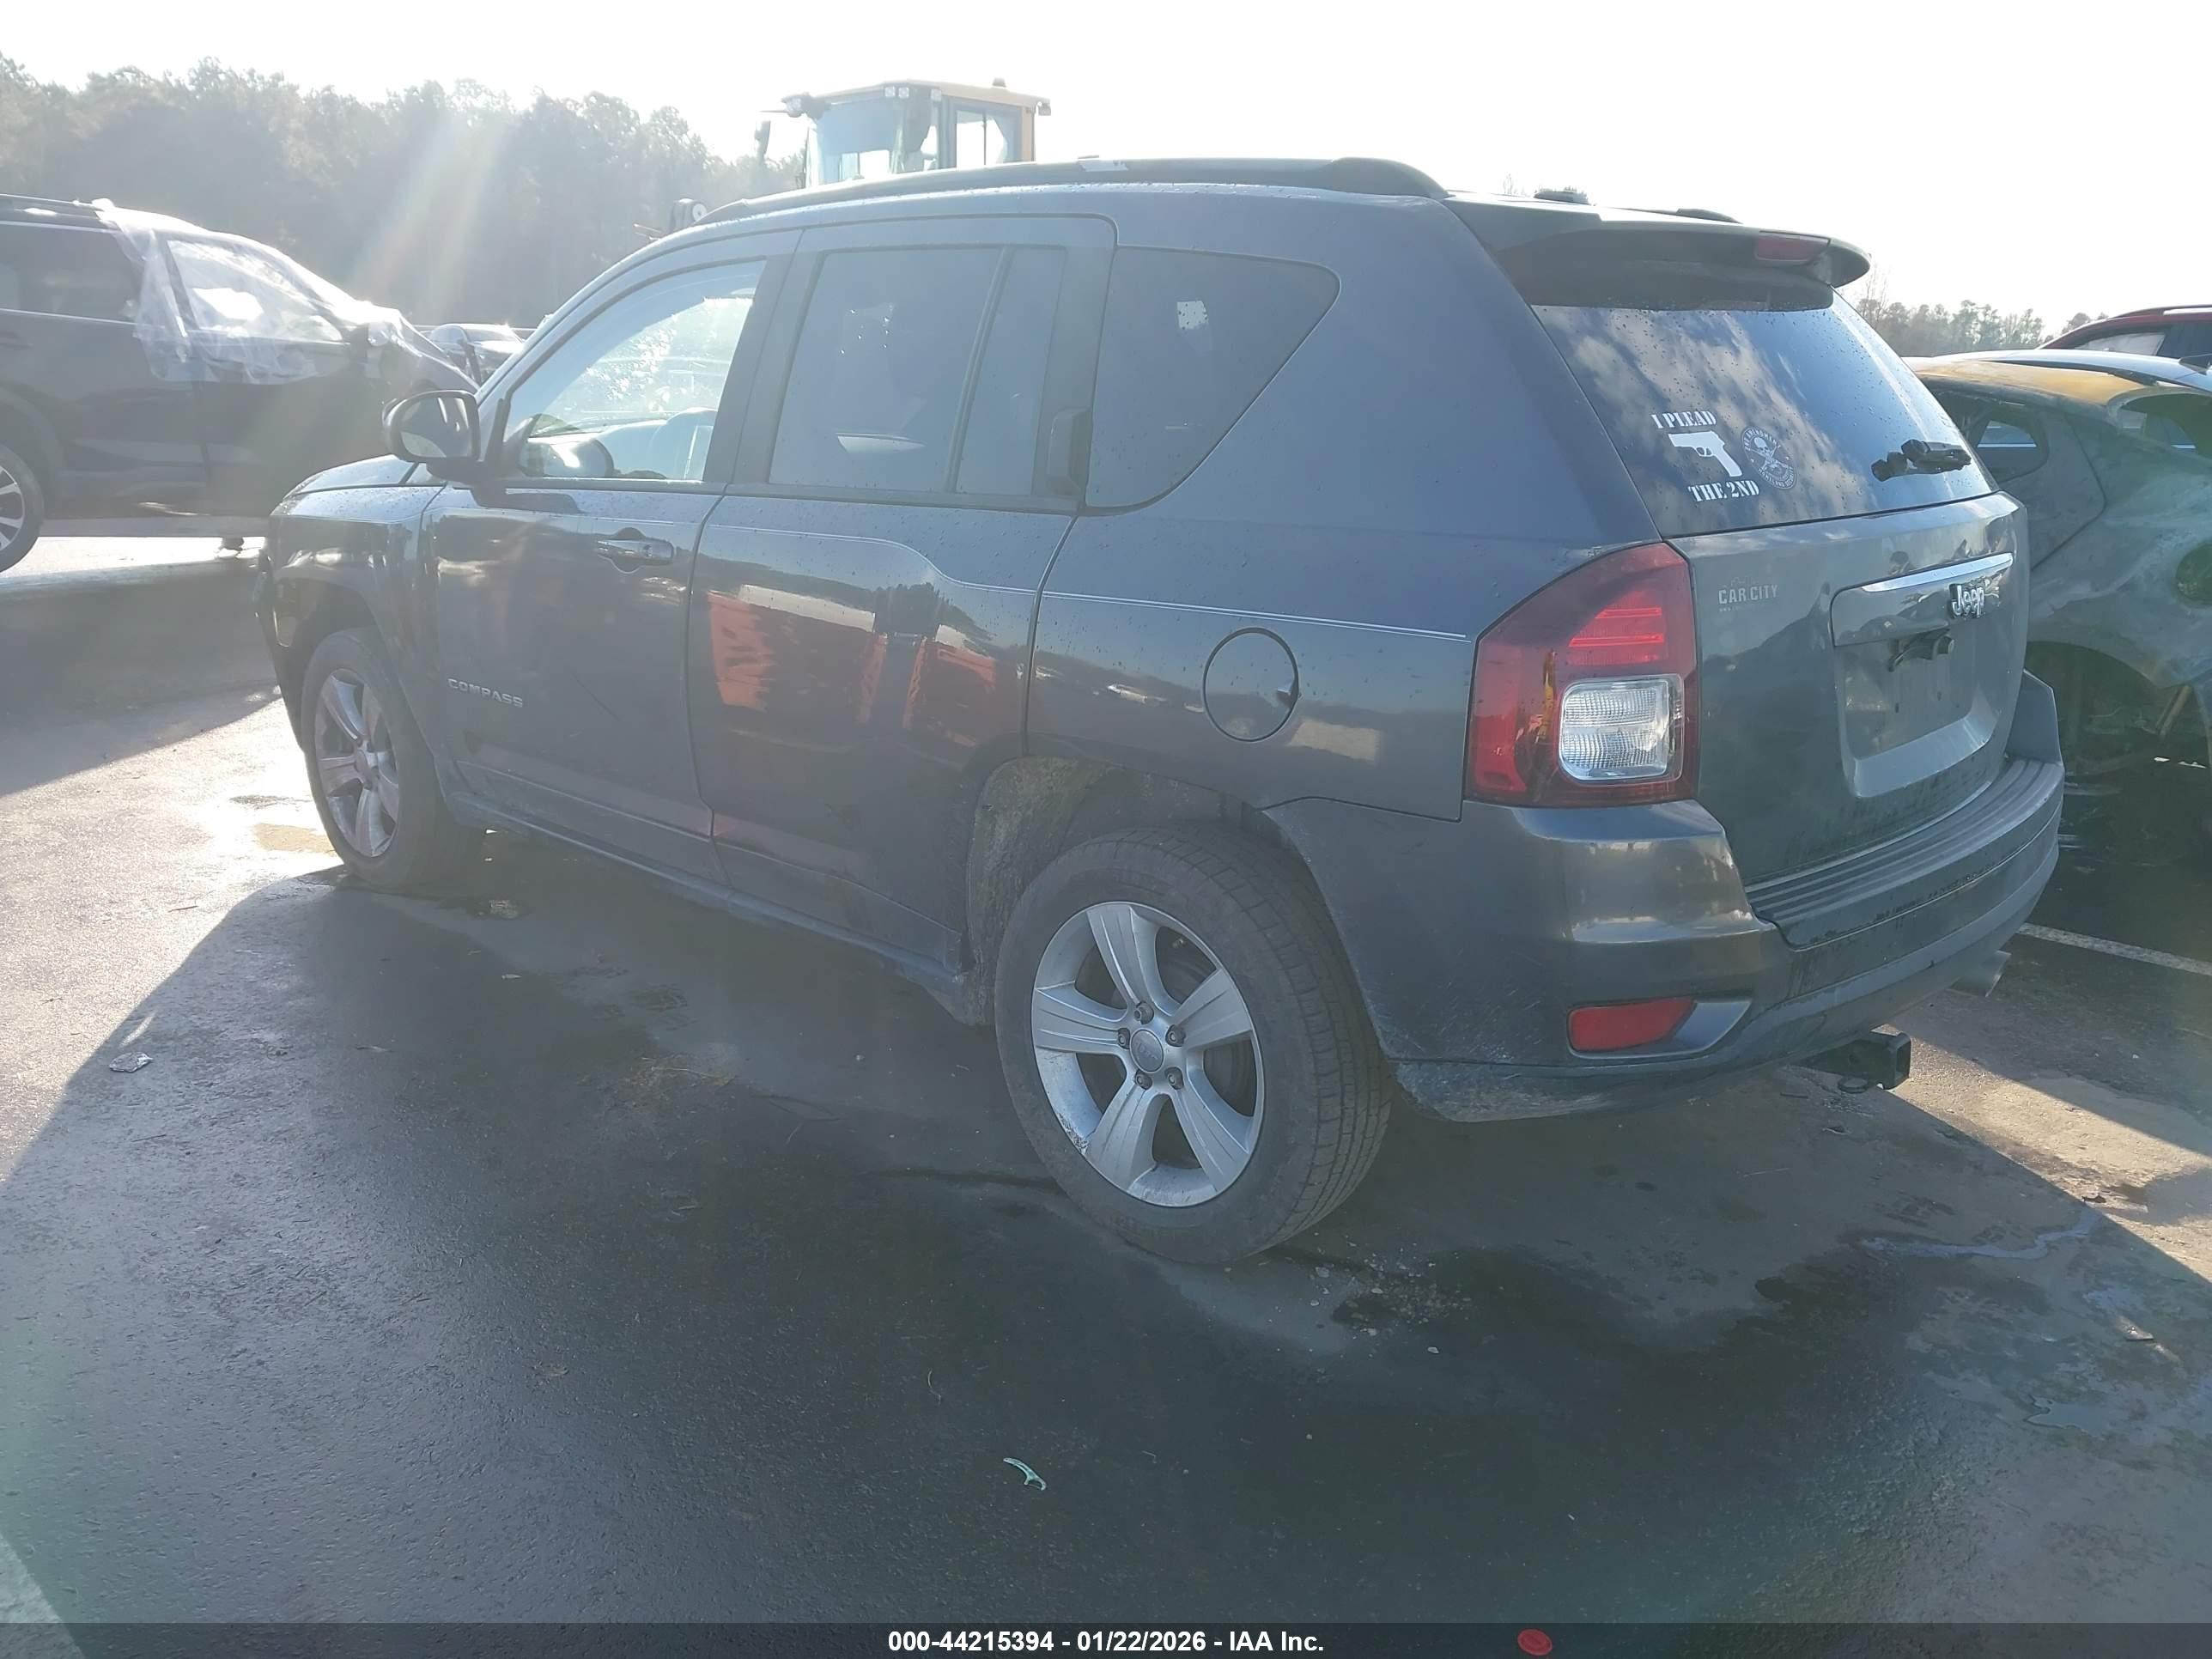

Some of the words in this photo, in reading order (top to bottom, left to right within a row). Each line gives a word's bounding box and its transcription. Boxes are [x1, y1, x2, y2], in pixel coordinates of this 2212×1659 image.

[1651, 414, 1664, 428] I
[1662, 411, 1717, 428] PLEAD
[1687, 483, 1728, 501] THE
[1726, 481, 1759, 498] 2ND
[1718, 587, 1747, 605] CAR
[1750, 585, 1778, 600] CITY
[1952, 585, 1984, 617] Jeep
[447, 678, 523, 708] COMPASS
